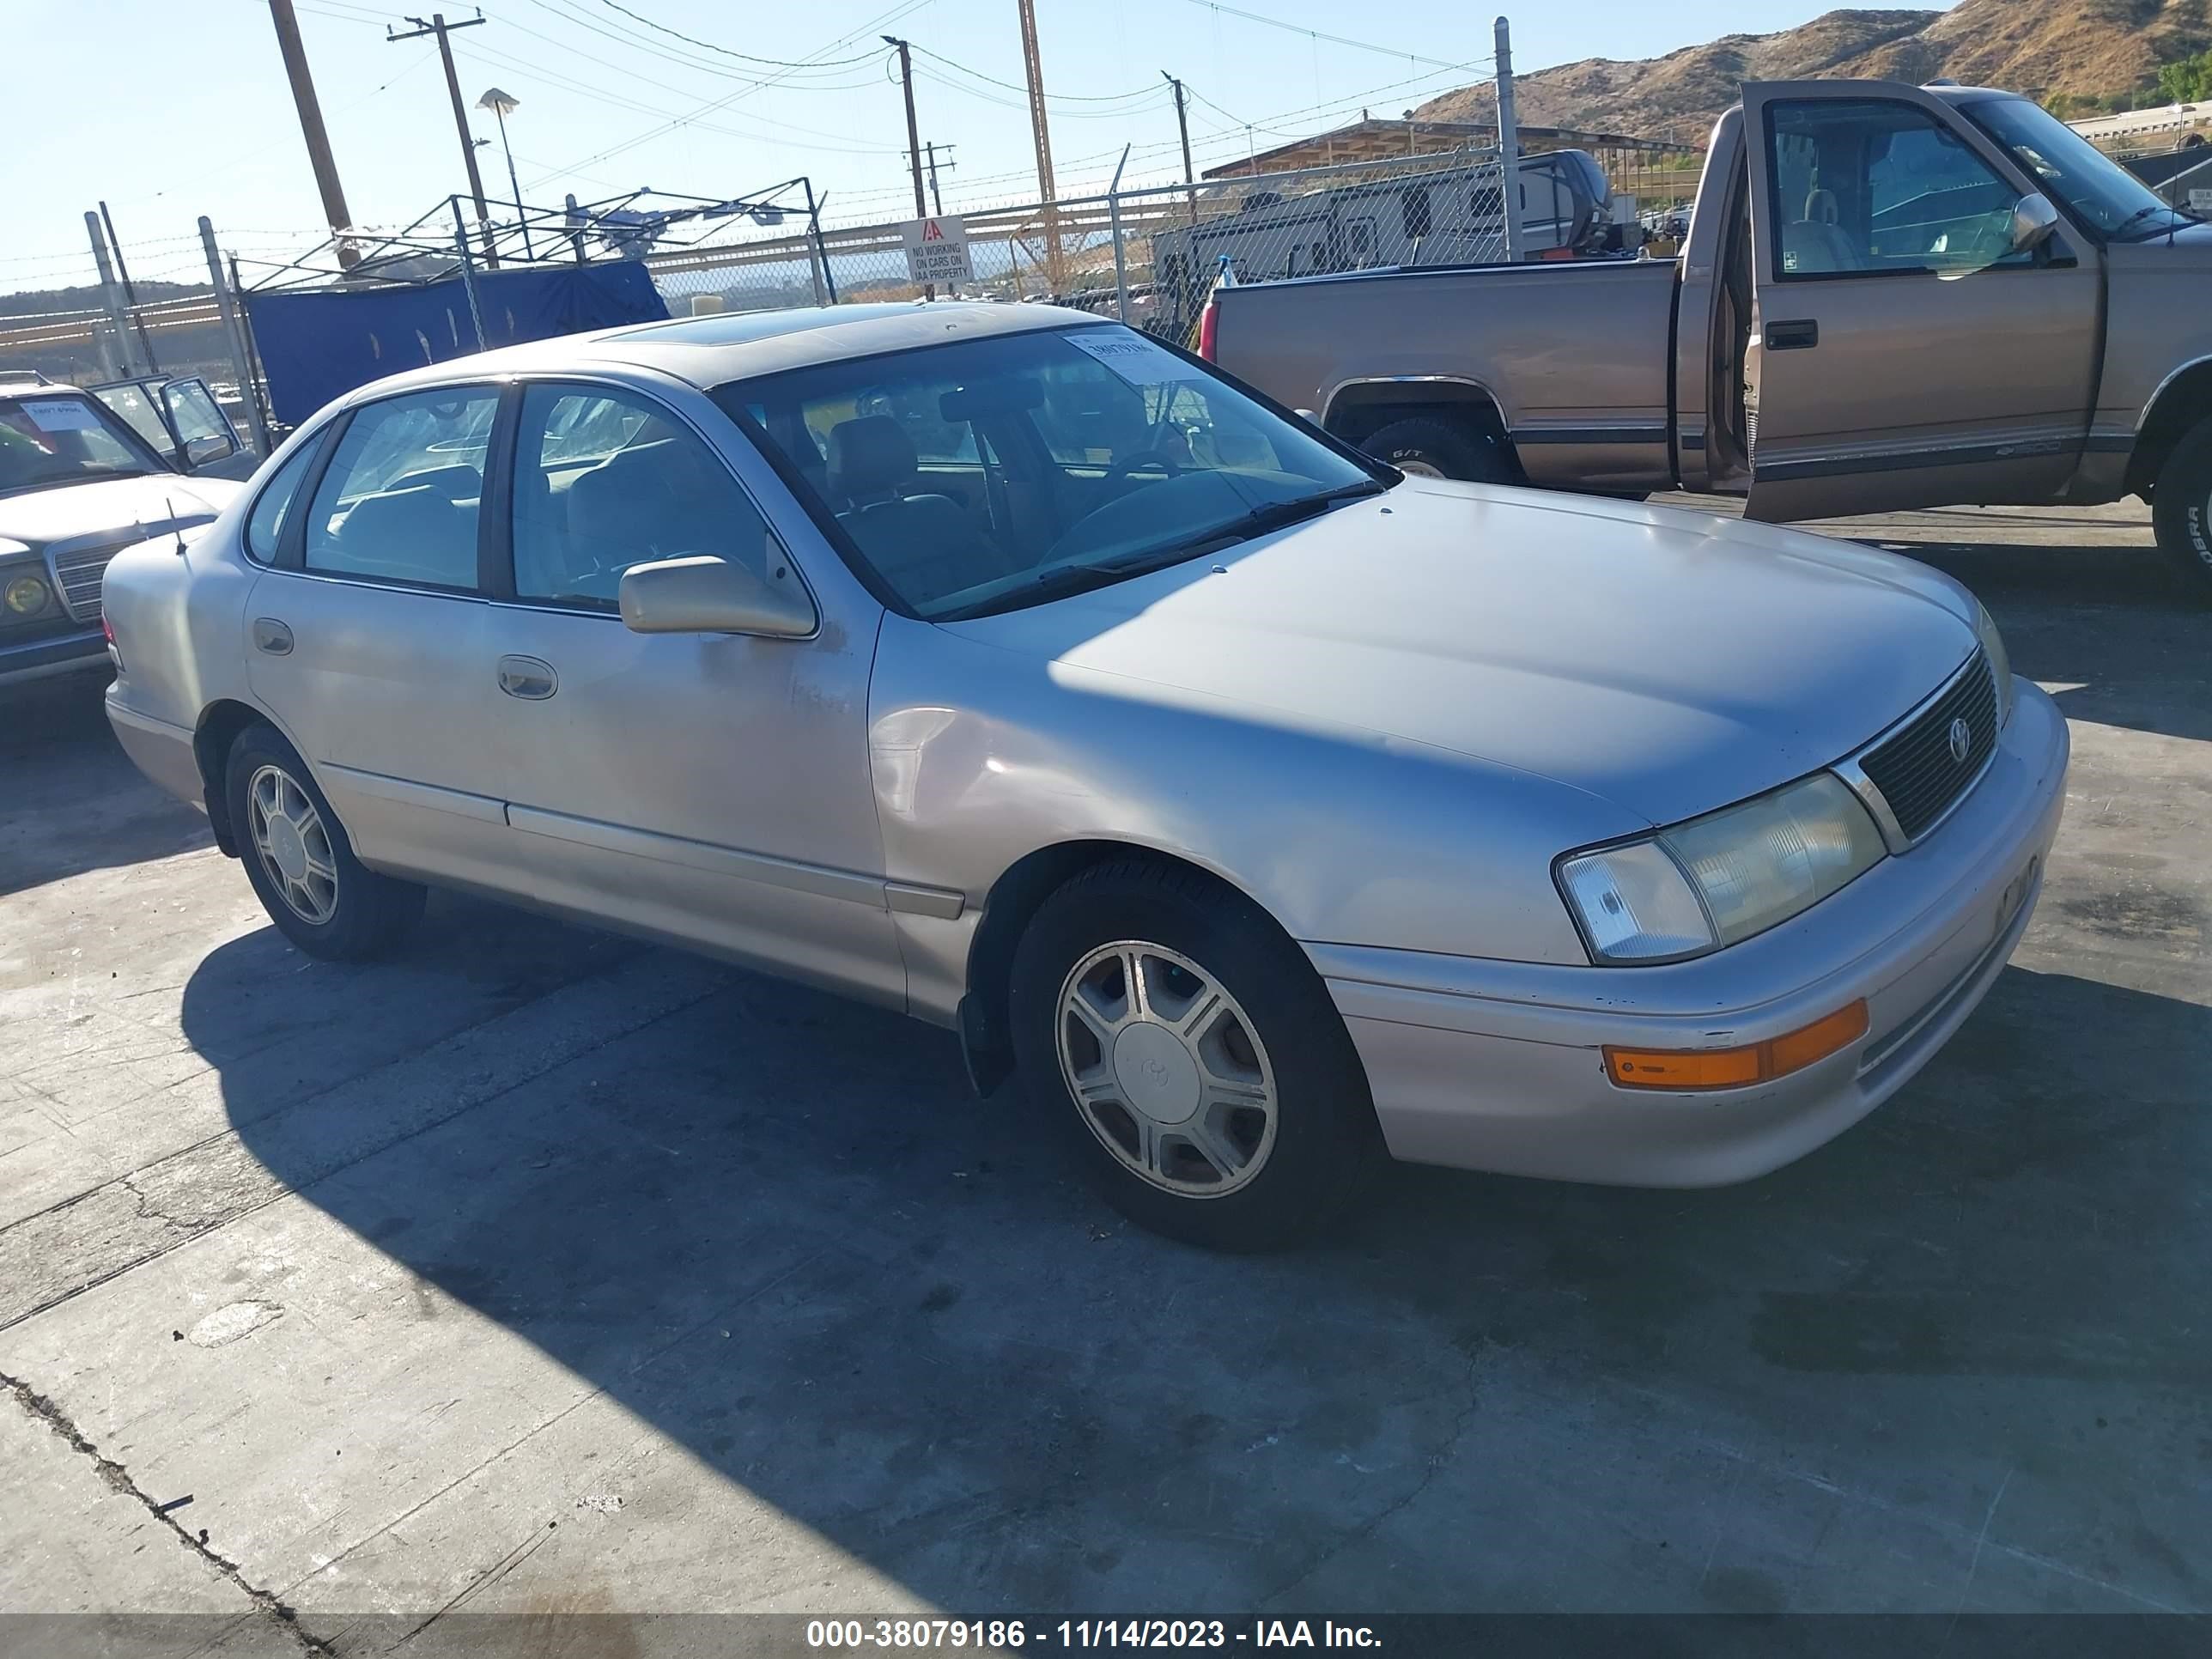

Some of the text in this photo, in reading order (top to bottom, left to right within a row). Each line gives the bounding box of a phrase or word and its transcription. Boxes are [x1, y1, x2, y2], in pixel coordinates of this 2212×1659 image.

[913, 242, 961, 258] NO WORKING
[916, 255, 963, 270] ON CARS ON
[915, 267, 968, 282] IAA PROPERTY
[2188, 507, 2212, 568] OBRA
